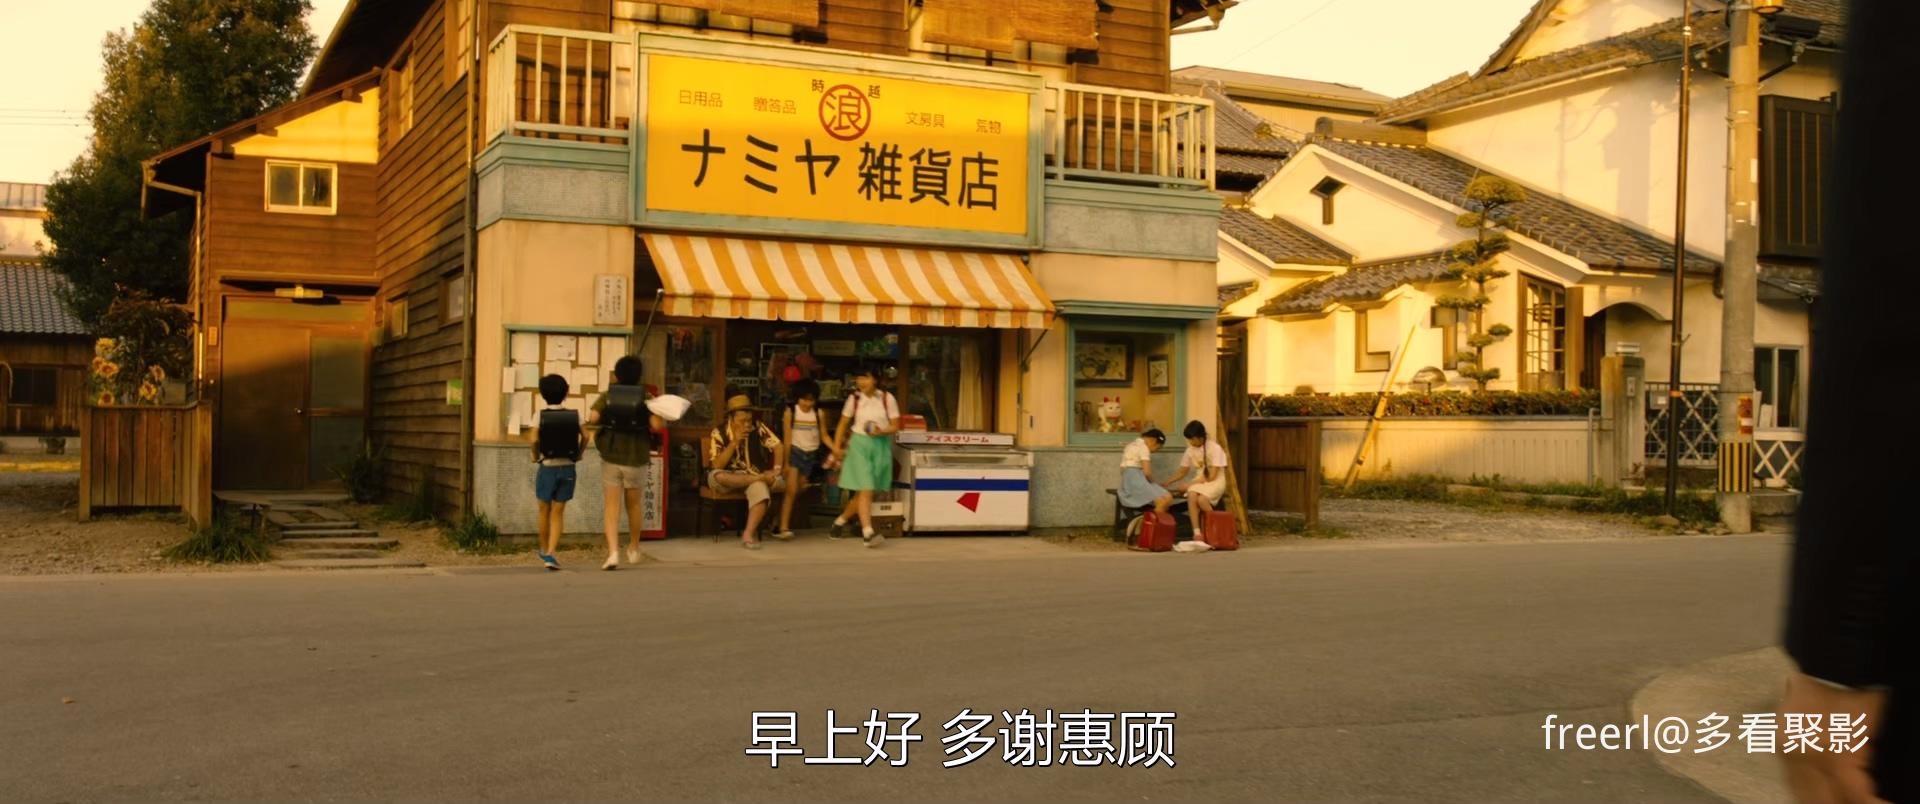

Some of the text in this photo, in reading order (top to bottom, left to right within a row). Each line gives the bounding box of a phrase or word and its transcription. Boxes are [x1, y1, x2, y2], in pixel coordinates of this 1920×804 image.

[679, 89, 723, 108] 日用品
[753, 96, 797, 115] 贈答品
[811, 79, 825, 93] 時
[824, 90, 865, 135] 浪
[905, 111, 945, 129] 文房具
[976, 119, 1002, 135] 荒物
[926, 435, 989, 443] アイスクリーム
